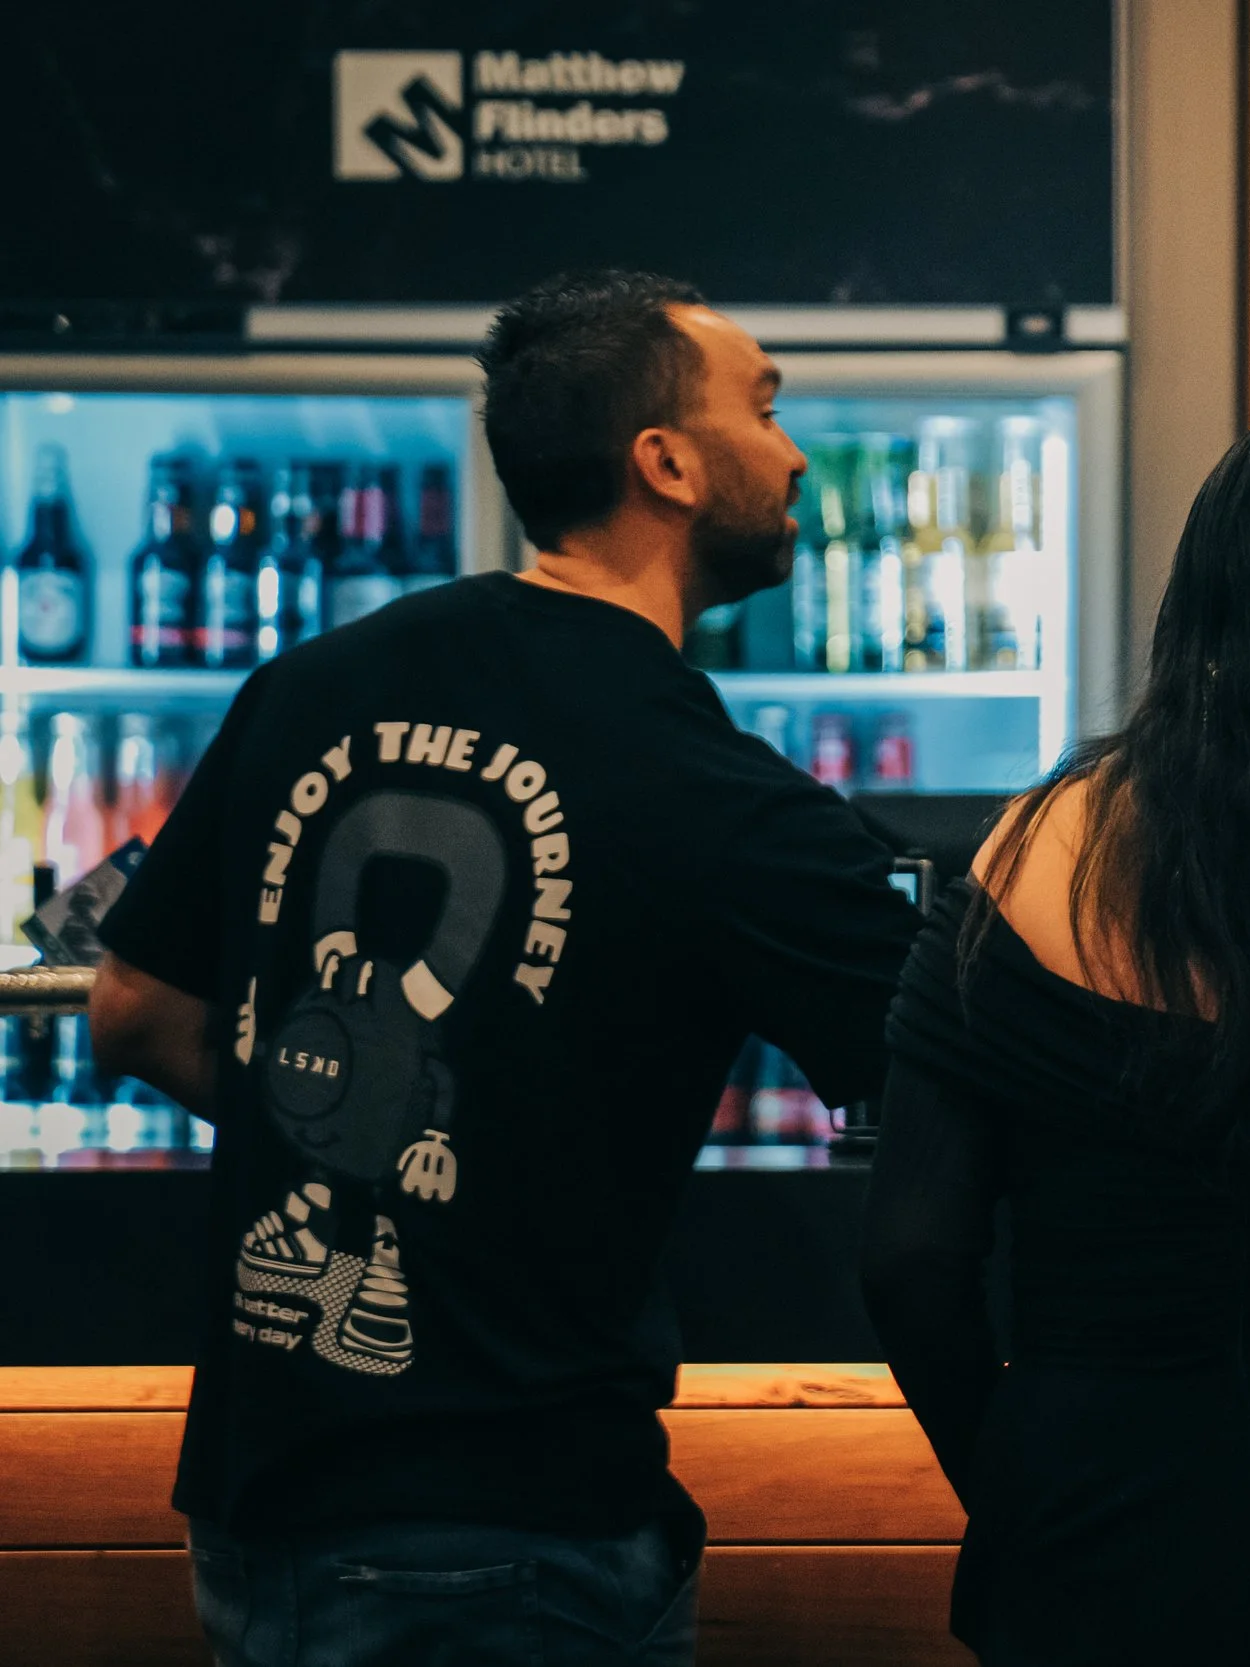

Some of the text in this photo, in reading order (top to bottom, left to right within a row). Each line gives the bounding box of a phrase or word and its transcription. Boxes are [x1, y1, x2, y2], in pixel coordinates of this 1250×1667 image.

[474, 50, 684, 93] Matthew
[474, 101, 669, 144] Flinders
[477, 149, 585, 178] HOTEL
[258, 721, 574, 1005] ENJOY THE JOURNEY
[257, 1326, 303, 1350] day
